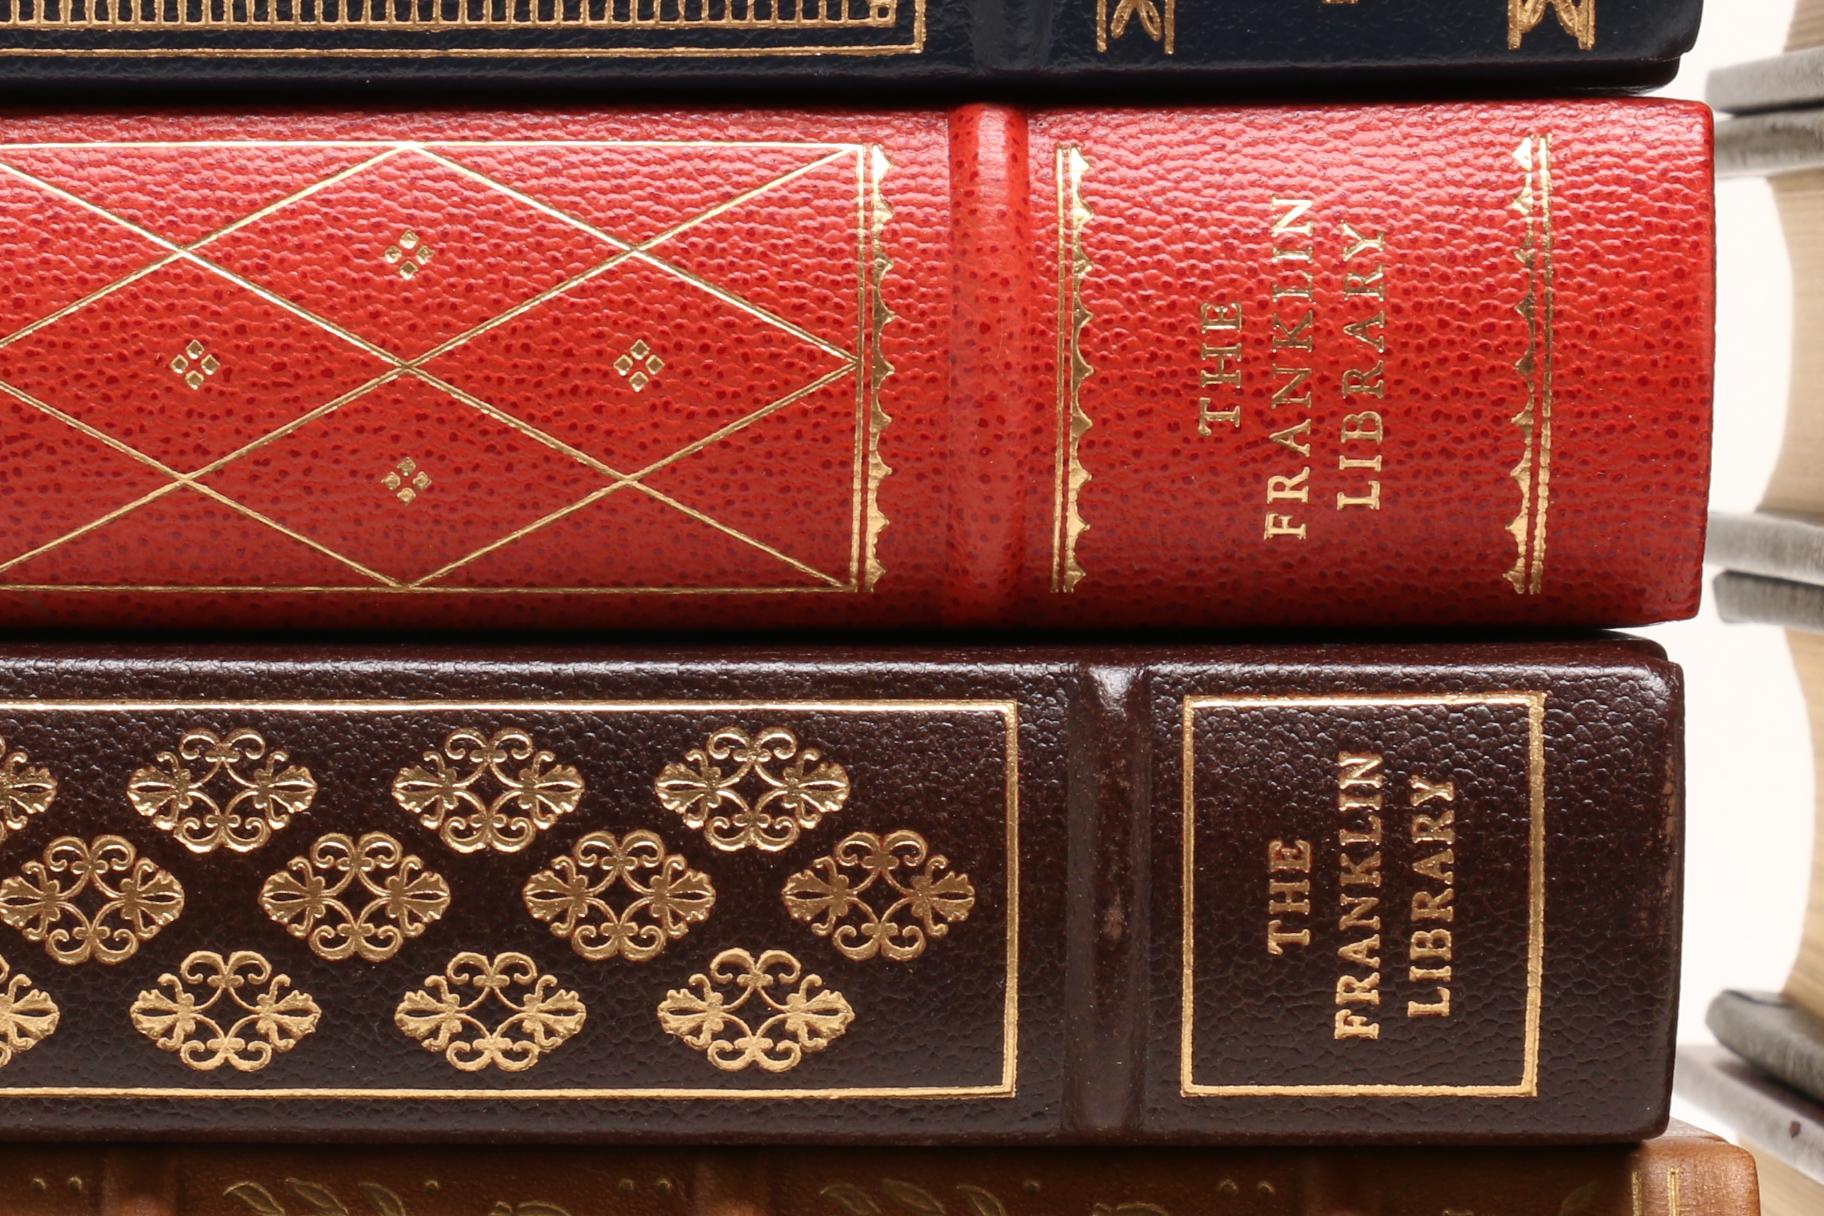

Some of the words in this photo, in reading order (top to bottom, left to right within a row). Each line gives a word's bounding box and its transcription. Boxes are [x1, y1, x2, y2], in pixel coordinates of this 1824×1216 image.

[1199, 302, 1243, 435] THE
[1265, 197, 1314, 540] FRANKLIN
[1336, 224, 1386, 511] LIBRARY
[1268, 840, 1312, 955] THE
[1334, 751, 1382, 1040] FRANKLIN
[1407, 775, 1456, 1018] LIBRARY
